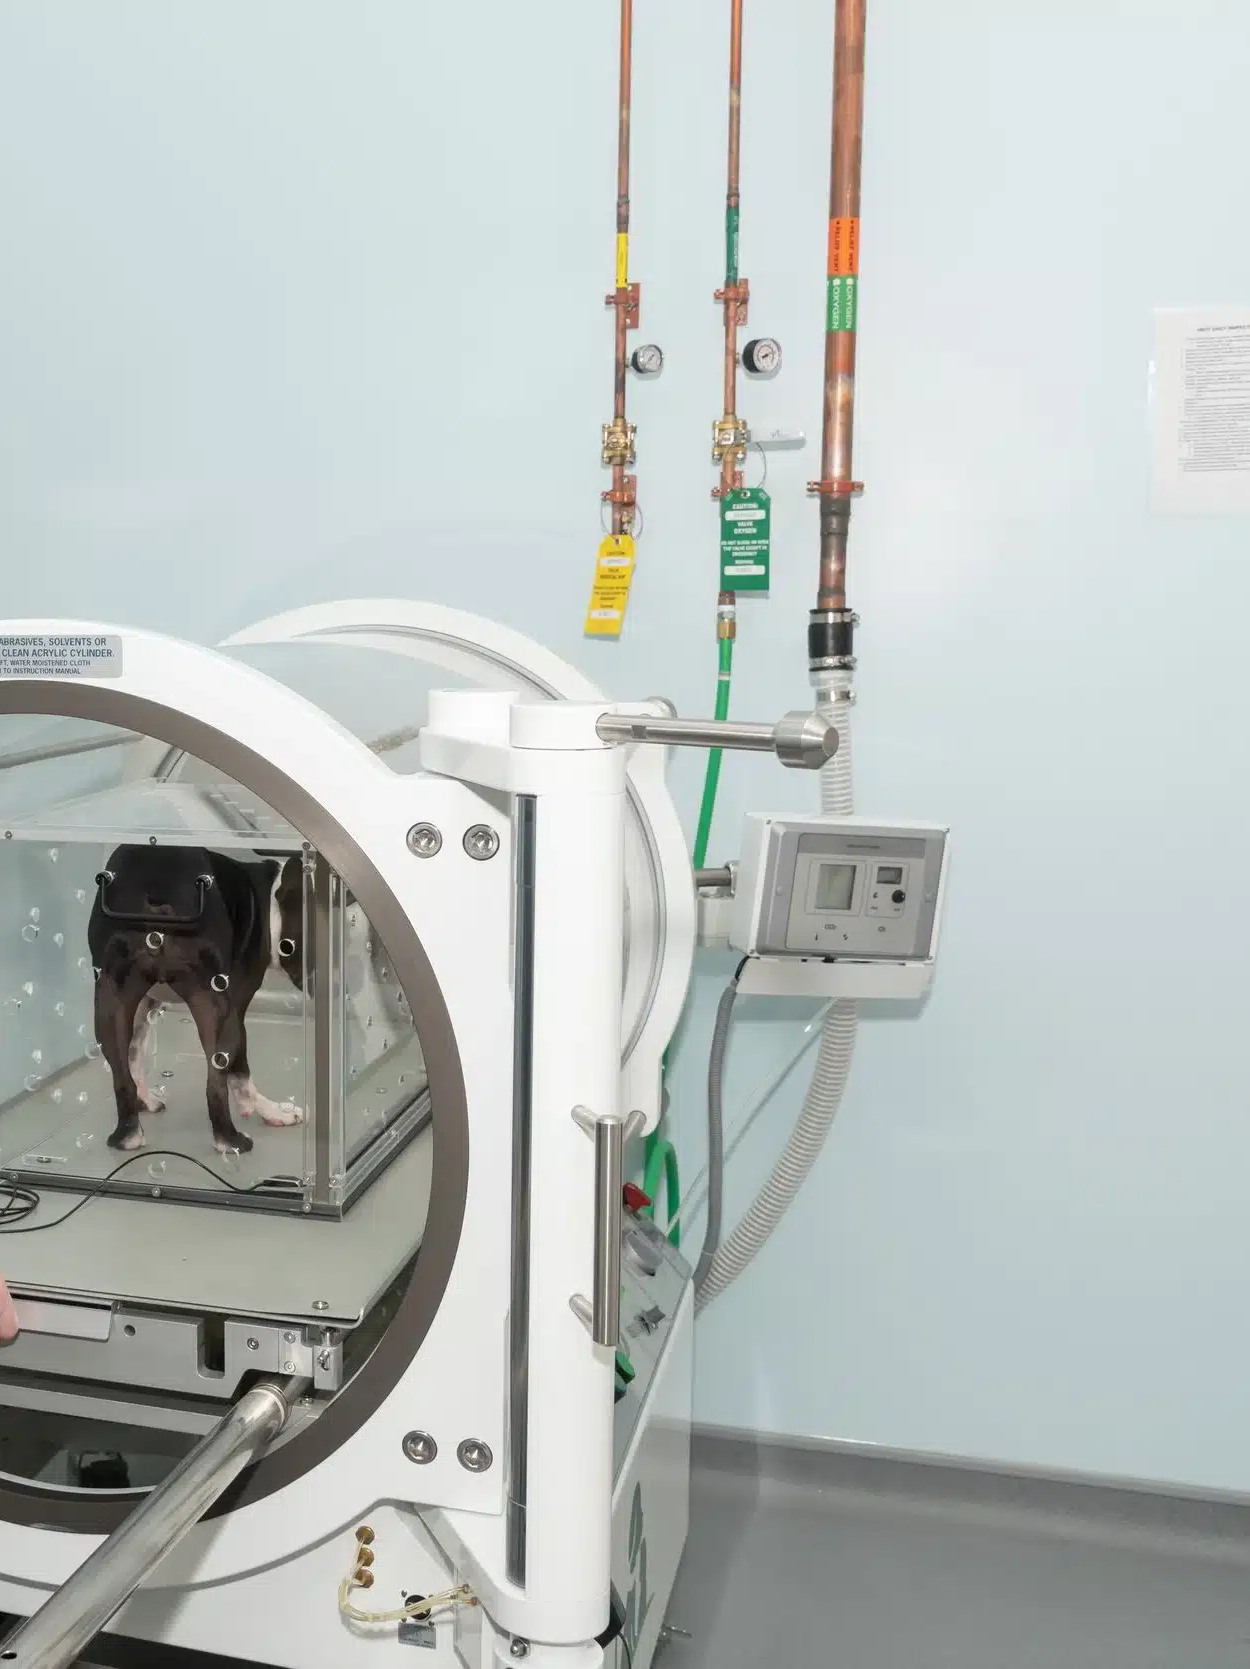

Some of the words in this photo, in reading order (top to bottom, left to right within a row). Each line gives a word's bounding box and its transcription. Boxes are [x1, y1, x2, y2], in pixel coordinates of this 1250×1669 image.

[832, 286, 840, 329] OXYGEN
[845, 285, 854, 329] OXYGEN
[1, 649, 29, 657] CLEAN
[31, 649, 68, 657] ACRYLIC
[69, 649, 115, 657] CYLINDER.
[48, 637, 92, 646] SOLVENTS
[94, 637, 107, 646] OR
